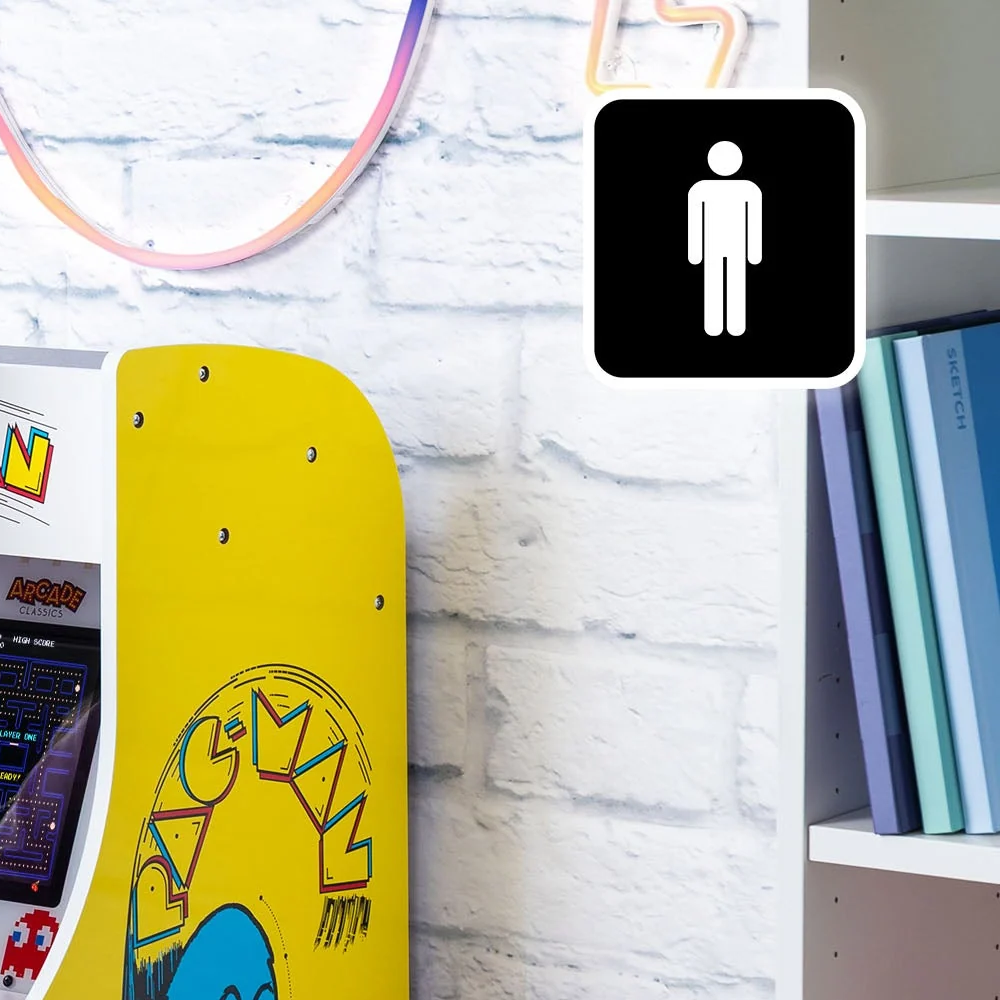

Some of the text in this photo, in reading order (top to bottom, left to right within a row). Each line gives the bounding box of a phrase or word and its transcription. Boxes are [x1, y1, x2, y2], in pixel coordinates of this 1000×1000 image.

[947, 347, 967, 430] SKETCH
[5, 577, 87, 613] ARCADE
[19, 606, 63, 618] CLASSICS
[12, 635, 55, 648] HIGH SCORE
[23, 733, 38, 742] ONE
[131, 687, 372, 950] PAC-MAN
